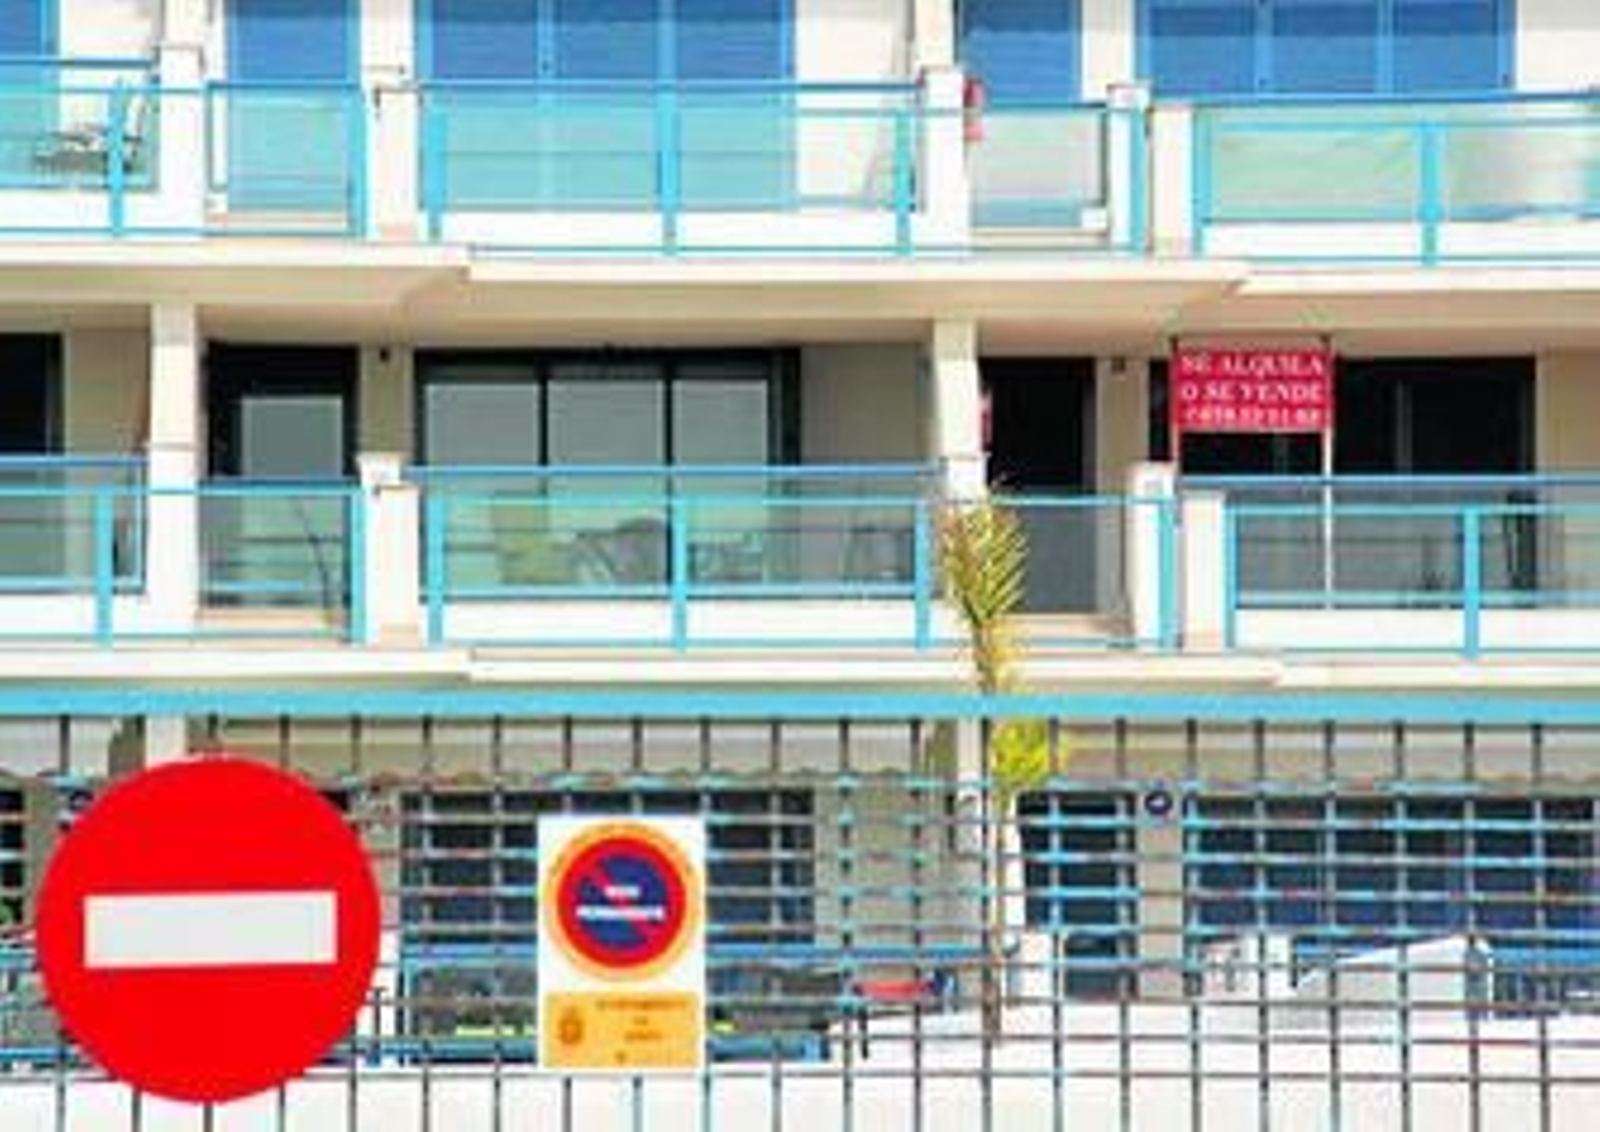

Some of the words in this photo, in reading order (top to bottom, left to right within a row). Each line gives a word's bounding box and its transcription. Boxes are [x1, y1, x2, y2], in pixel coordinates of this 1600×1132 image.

[1219, 354, 1324, 378] ALQUILA
[1181, 381, 1198, 401] O
[1203, 382, 1236, 401] SE
[1240, 383, 1324, 404] VENDE
